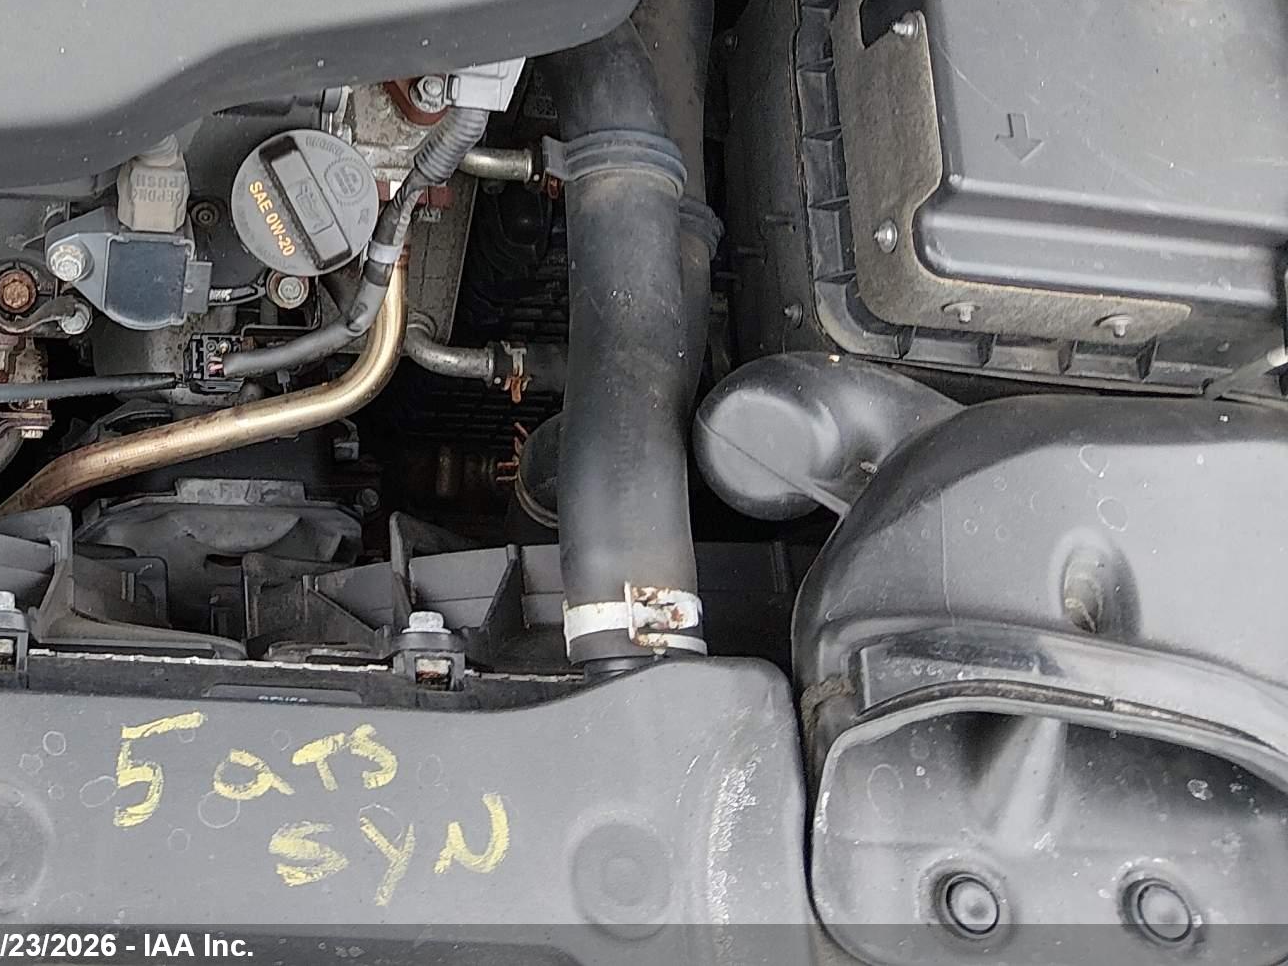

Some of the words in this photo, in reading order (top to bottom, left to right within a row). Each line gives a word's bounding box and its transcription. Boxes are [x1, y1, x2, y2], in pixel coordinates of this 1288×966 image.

[249, 181, 274, 213] SAE
[265, 208, 296, 256] 0W-20
[113, 710, 207, 828] 5
[268, 792, 511, 907] SYN
